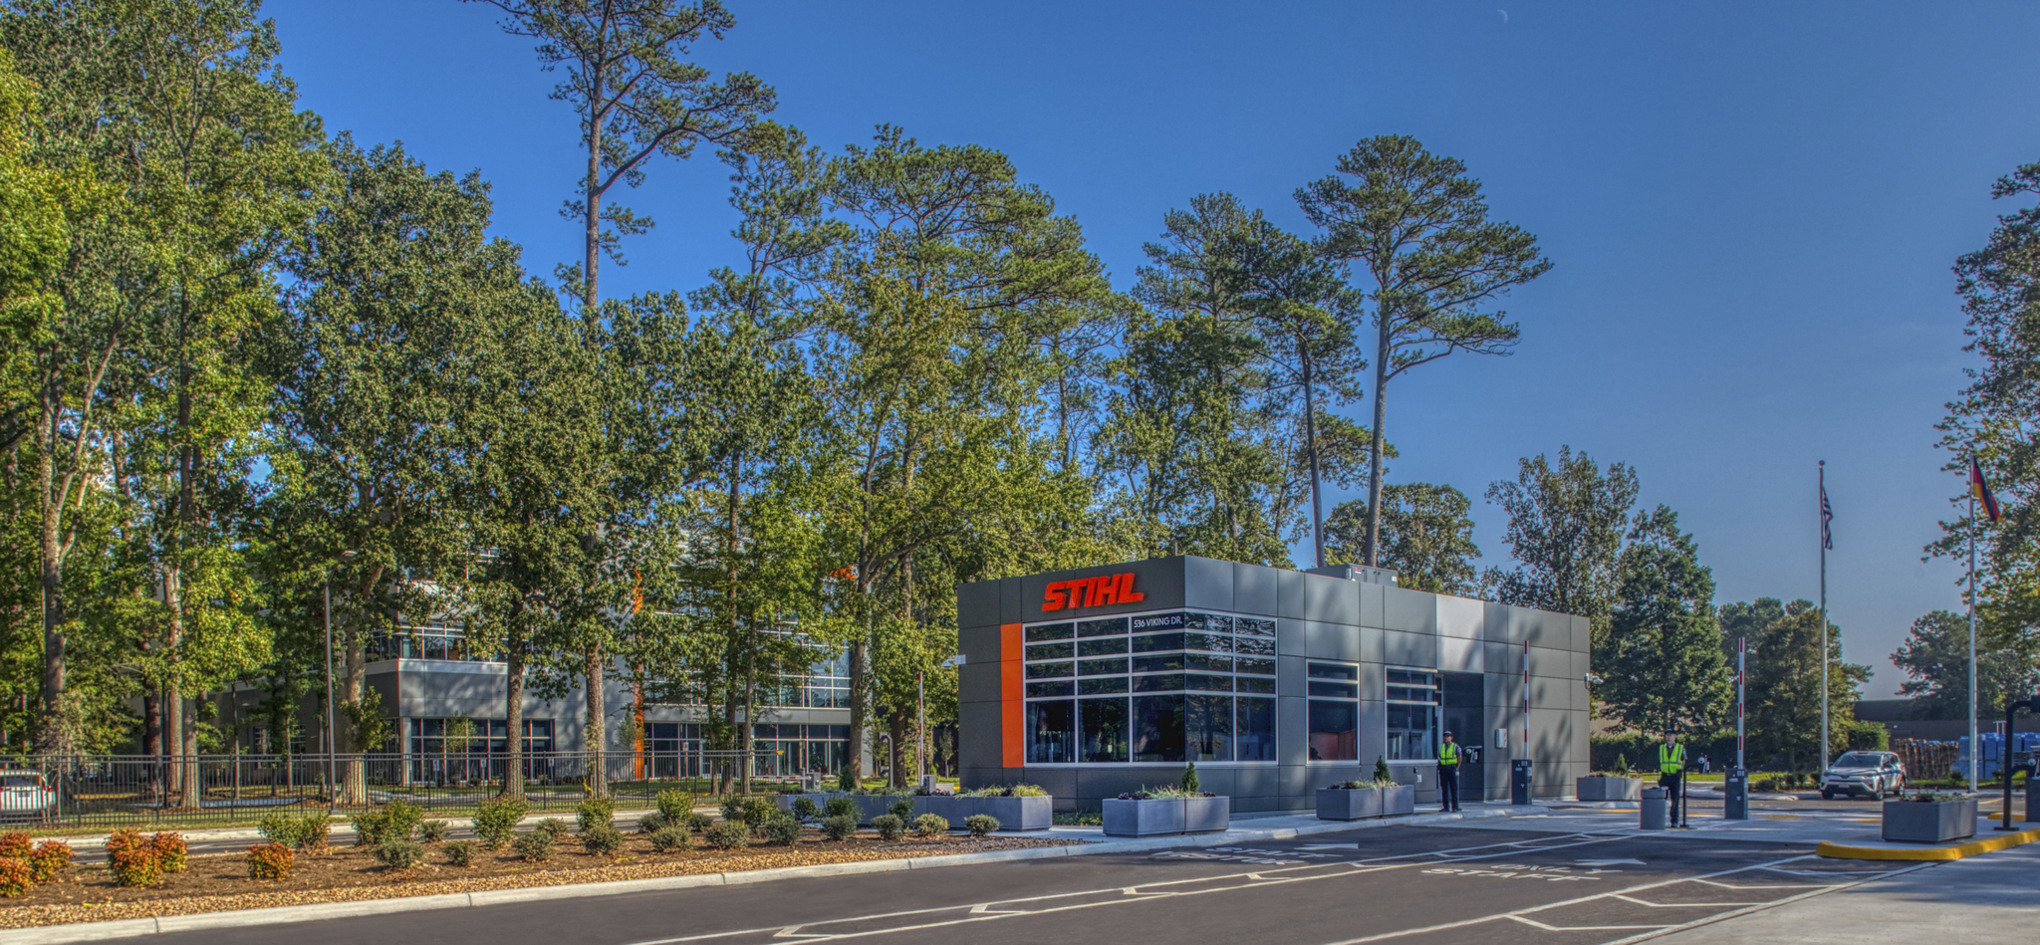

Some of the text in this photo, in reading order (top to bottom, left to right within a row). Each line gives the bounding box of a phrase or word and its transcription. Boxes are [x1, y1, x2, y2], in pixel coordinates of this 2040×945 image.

[1041, 572, 1144, 611] STIHL
[1133, 616, 1182, 628] 536 VIKING DR.
[1421, 868, 1602, 882] STAFF
